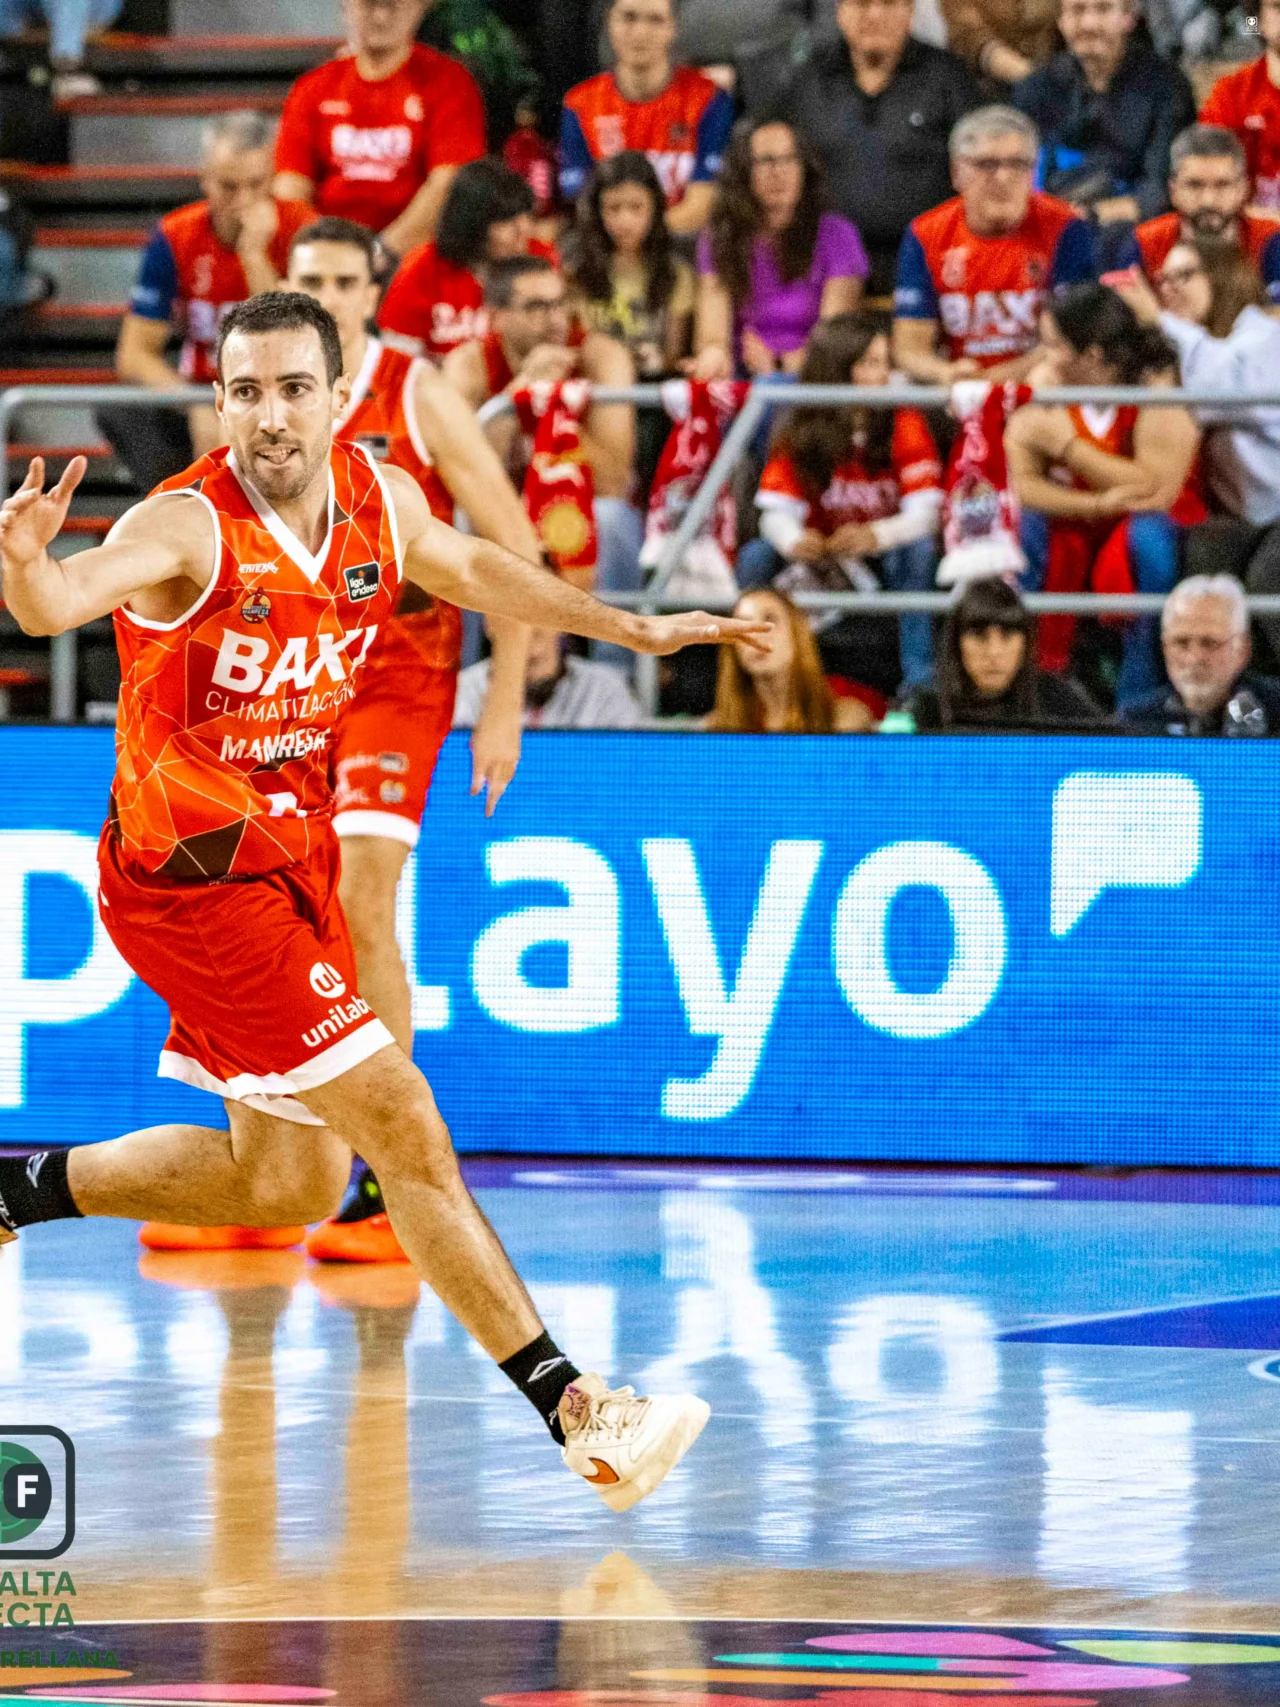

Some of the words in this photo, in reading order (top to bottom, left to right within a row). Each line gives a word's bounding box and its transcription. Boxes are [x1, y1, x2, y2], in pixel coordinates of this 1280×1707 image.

[351, 583, 378, 597] endesa
[211, 624, 379, 696] BAXI
[220, 727, 331, 762] MANRESA
